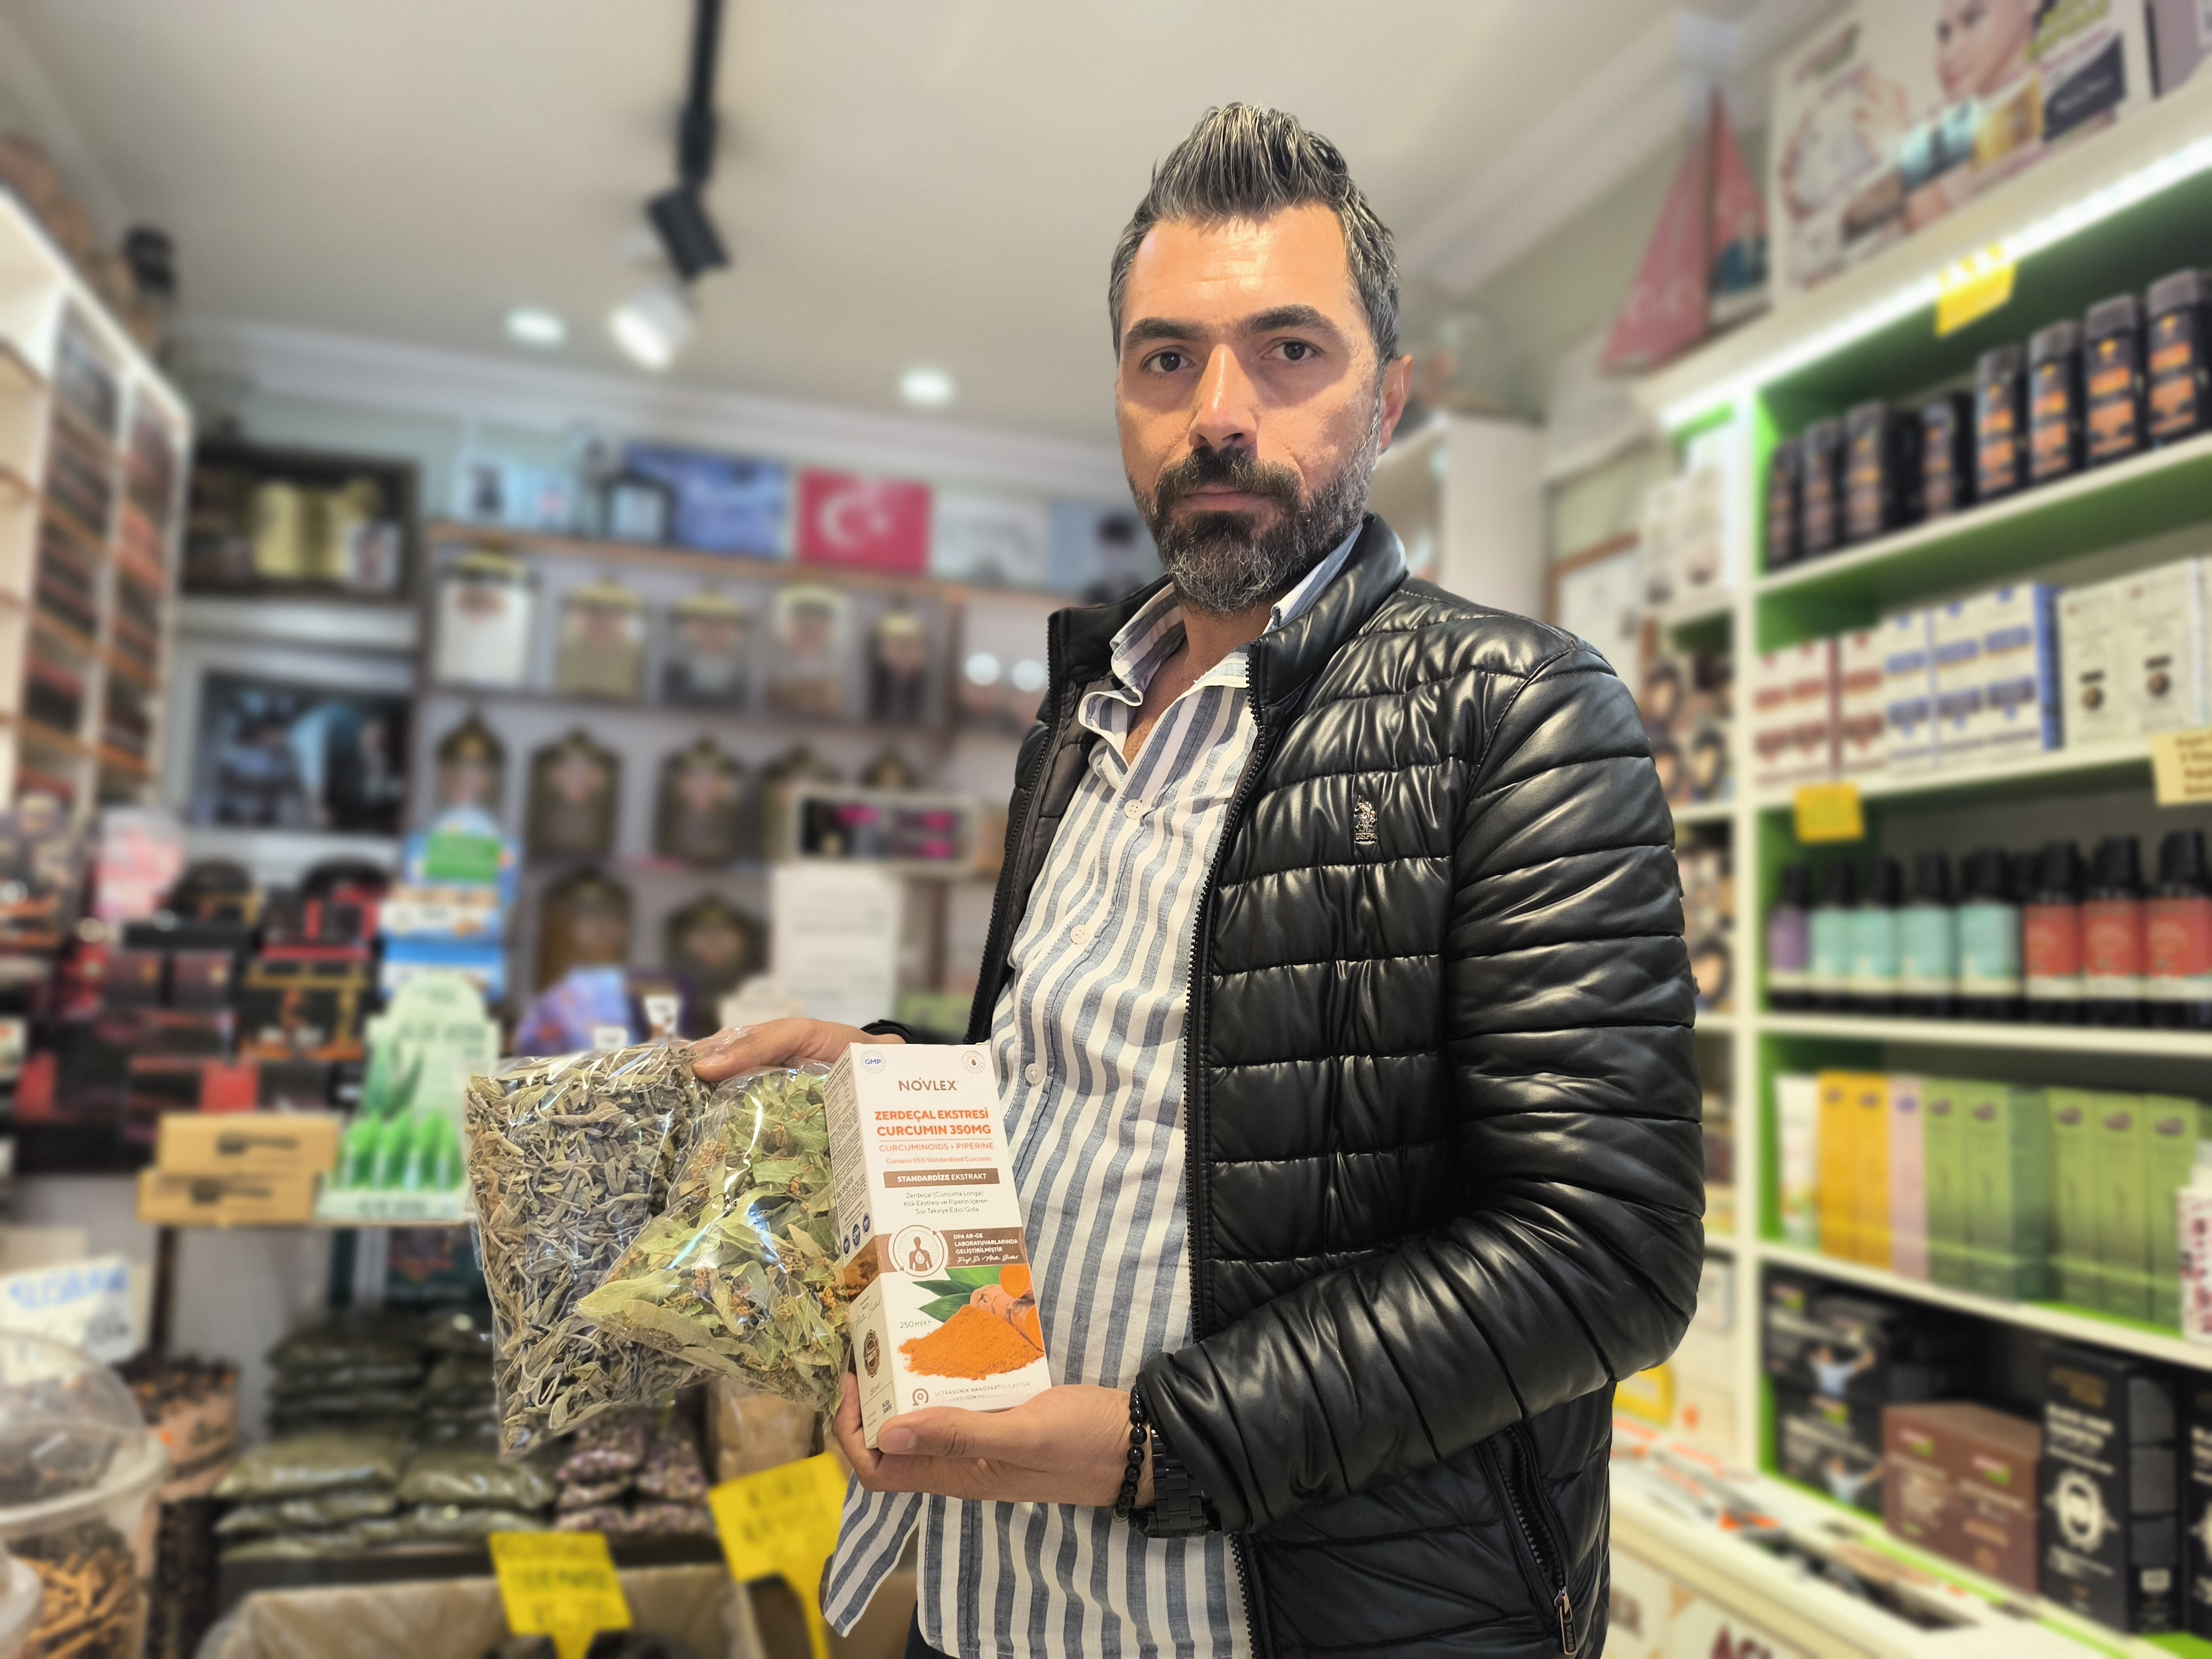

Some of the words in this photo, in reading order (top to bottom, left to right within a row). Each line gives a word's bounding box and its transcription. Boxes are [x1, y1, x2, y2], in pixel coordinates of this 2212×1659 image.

[874, 1110, 936, 1122] ZERDEÇAL
[937, 1107, 989, 1119] EKSTRESİ
[877, 1126, 947, 1136] CURCUMIN
[950, 1124, 992, 1135] 350MG
[879, 1143, 949, 1152] CURCUMINOIDS
[897, 1173, 950, 1183] STANDARDİZE
[951, 1173, 987, 1181] EKSTRAKT
[954, 1238, 1018, 1247] LABORATUVARLARINDA
[955, 1245, 1003, 1255] GELİŞTİRİLMİŞTİR
